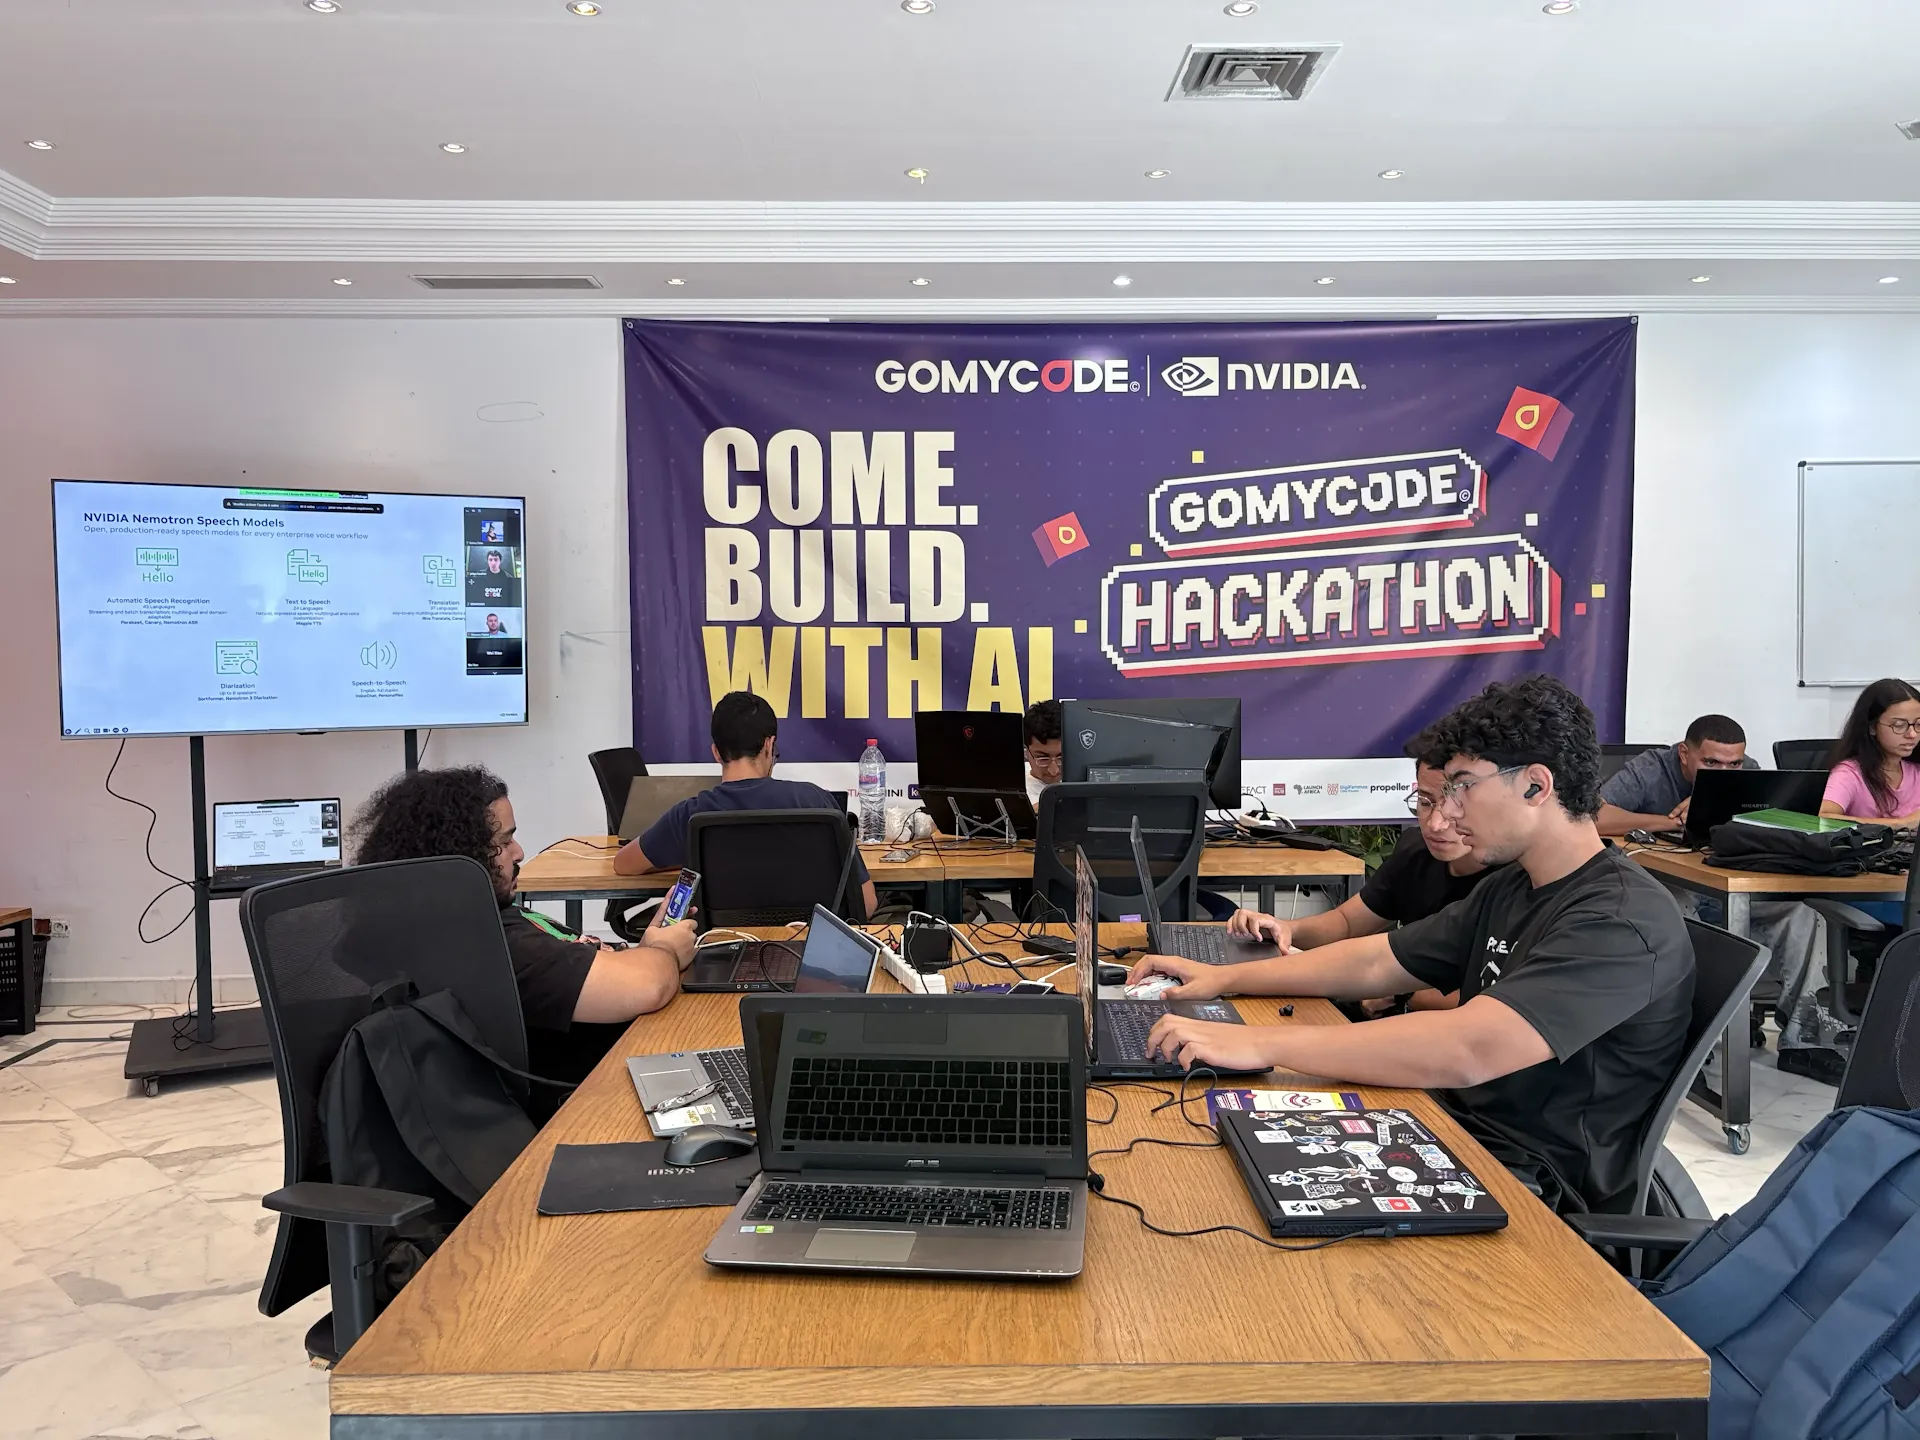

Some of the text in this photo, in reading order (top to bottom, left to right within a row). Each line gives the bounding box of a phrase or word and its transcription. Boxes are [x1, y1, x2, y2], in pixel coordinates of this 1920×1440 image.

[702, 427, 978, 526] COME.
[84, 512, 284, 528] NVIDIA Nemotron Speech Models
[84, 525, 108, 533] Open,
[110, 526, 180, 535] production-ready
[142, 572, 174, 582] Hello
[302, 570, 324, 578] Hello
[704, 528, 989, 623] BUILD.
[1121, 554, 1530, 648] HACKATHON
[702, 626, 943, 719] WITH
[1370, 783, 1410, 793] propeller
